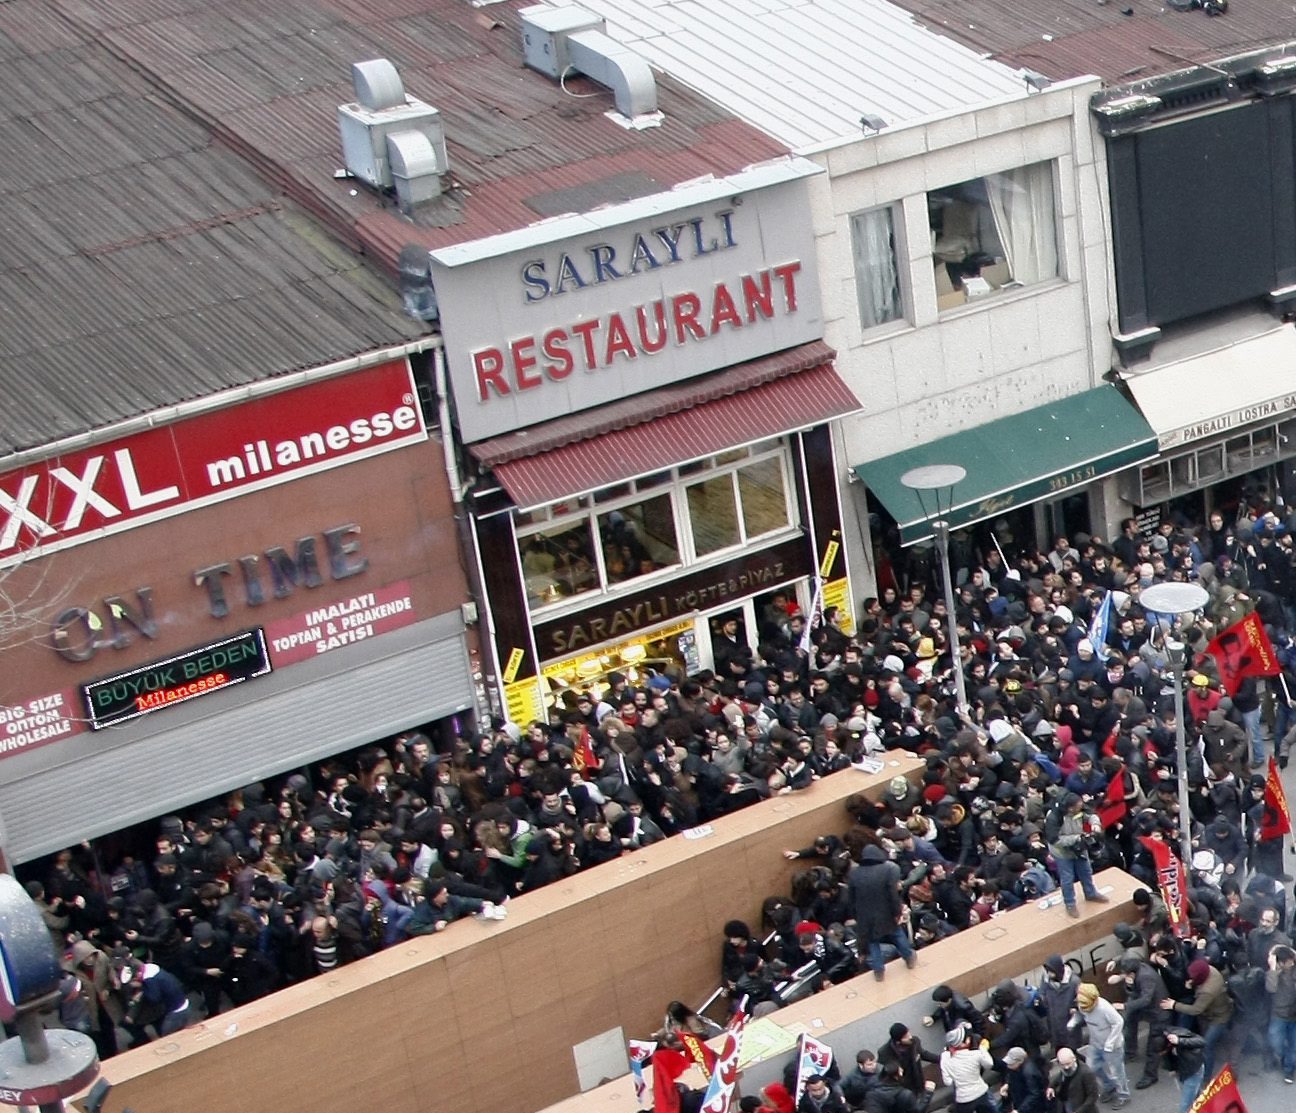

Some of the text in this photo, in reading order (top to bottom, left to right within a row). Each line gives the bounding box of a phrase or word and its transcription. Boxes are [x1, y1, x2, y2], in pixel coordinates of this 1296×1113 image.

[521, 212, 738, 304] SARAYLI
[471, 259, 801, 404] RESTAURANT
[205, 405, 417, 487] milanesse
[1183, 416, 1233, 441] PANGALTI
[1238, 402, 1278, 424] LOSTRA
[0, 447, 180, 552] XXL
[52, 522, 370, 662] ON TIME
[304, 592, 376, 627] IMALATI
[272, 624, 322, 653] TOPTAN
[341, 596, 413, 631] PERAKENDE
[315, 623, 375, 654] SATISI
[28, 692, 64, 715] SIZE
[98, 640, 258, 708] BÜYÜK BEDEN
[135, 671, 227, 711] Milanesse
